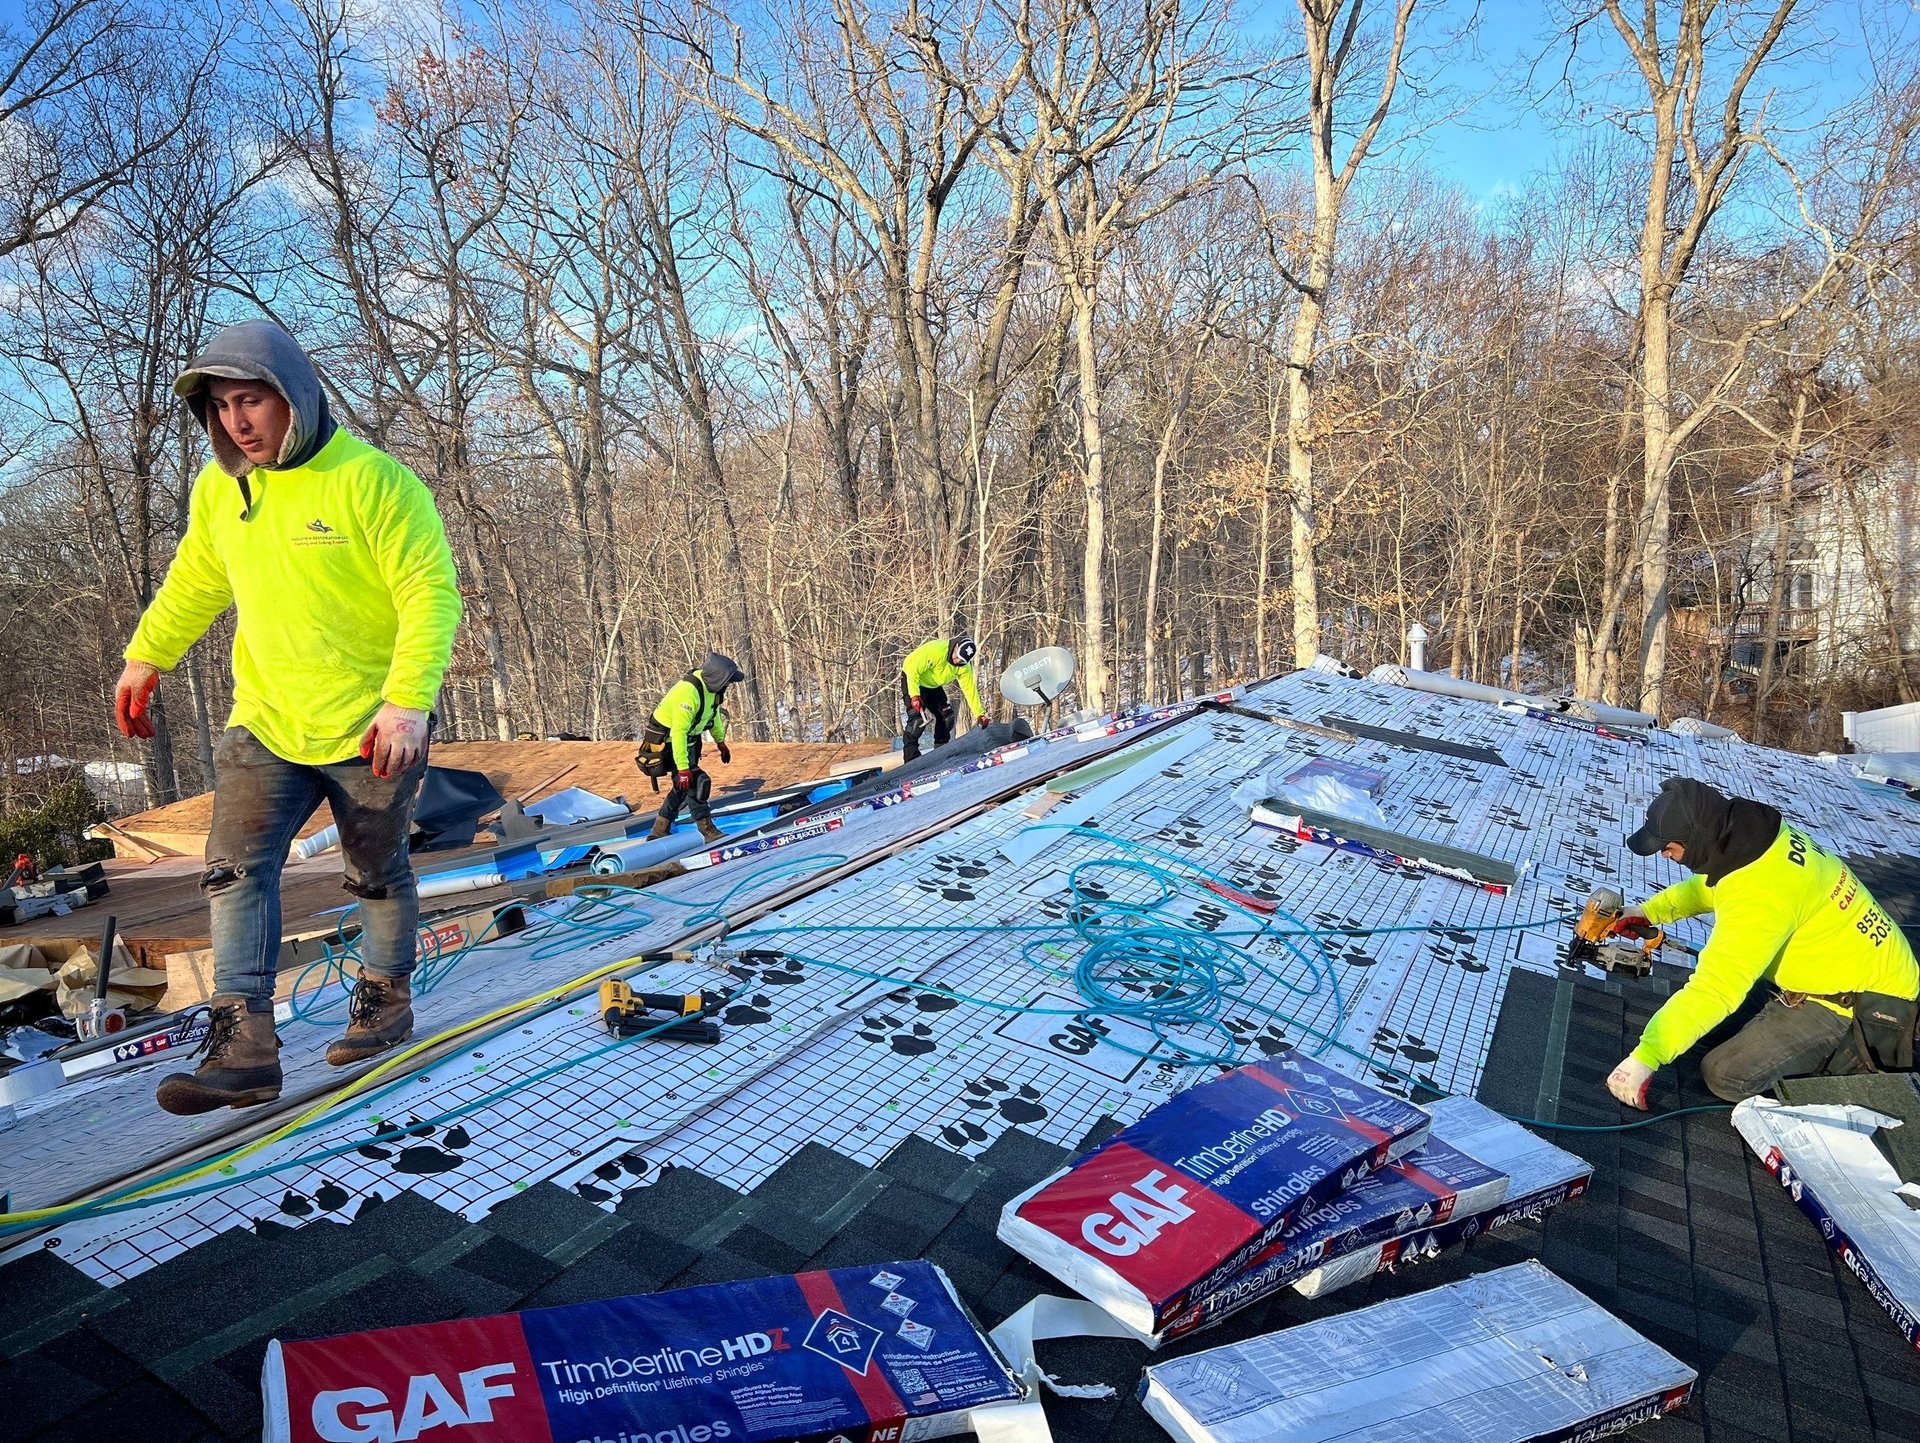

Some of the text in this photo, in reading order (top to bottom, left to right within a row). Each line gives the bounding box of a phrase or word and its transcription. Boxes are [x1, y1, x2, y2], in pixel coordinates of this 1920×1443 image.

[1022, 656, 1053, 675] DIRECTV
[1838, 886, 1857, 911] CALL
[1049, 1014, 1112, 1056] GAF
[1211, 1173, 1230, 1188] High
[1251, 1164, 1327, 1217] Shingles
[1081, 1169, 1197, 1257] GAF
[1440, 1198, 1455, 1212] NE
[1283, 1200, 1362, 1238] ingles
[1161, 1302, 1183, 1320] GAF
[1174, 1311, 1200, 1329] GAF
[842, 1335, 850, 1346] 4
[559, 1389, 593, 1405] High
[716, 1361, 765, 1381] Shingles
[937, 1387, 956, 1396] MADE
[964, 1383, 976, 1391] THE
[311, 1362, 517, 1443] GAF
[871, 1425, 900, 1443] NE
